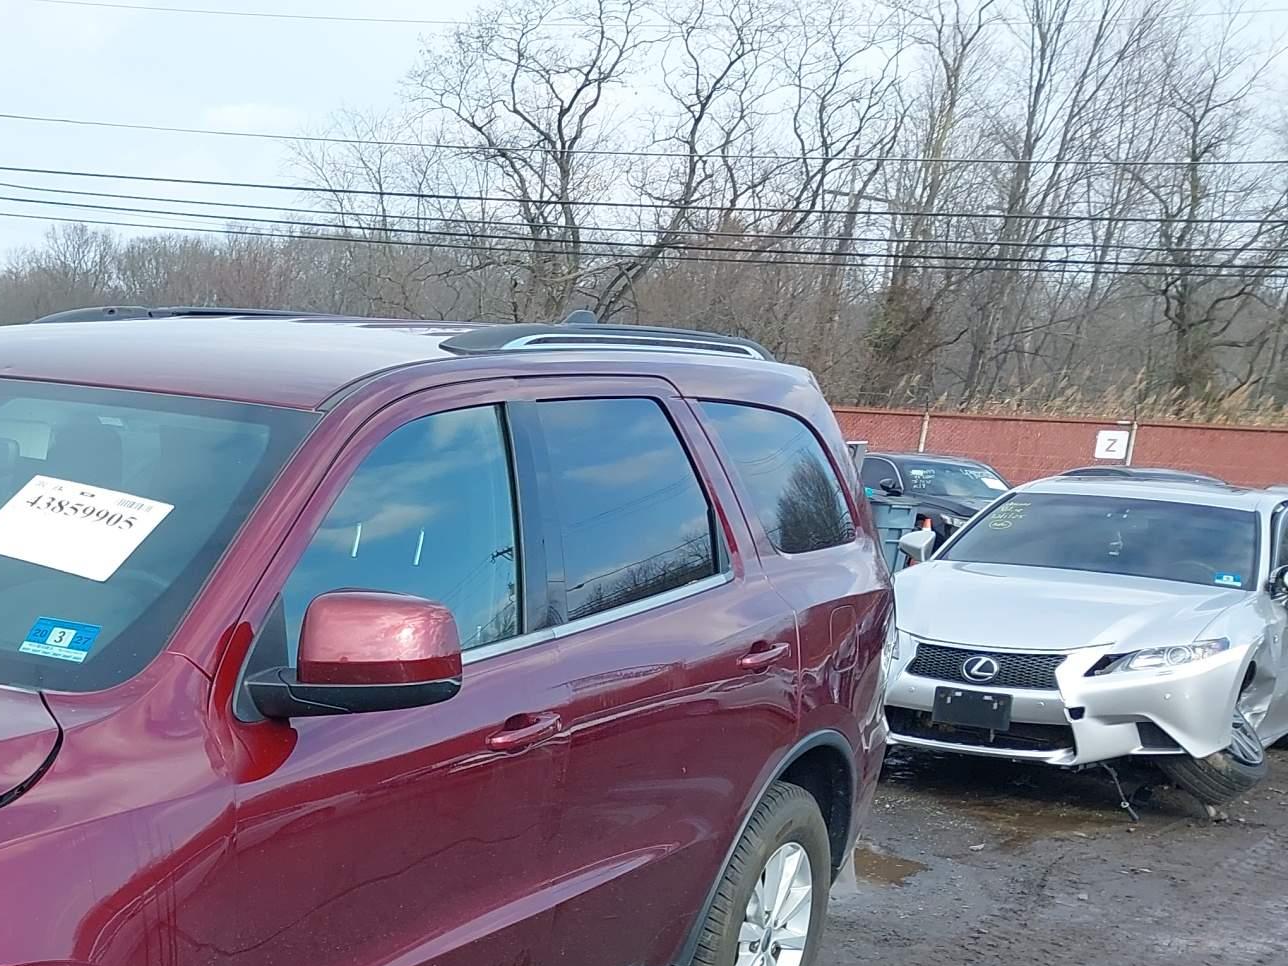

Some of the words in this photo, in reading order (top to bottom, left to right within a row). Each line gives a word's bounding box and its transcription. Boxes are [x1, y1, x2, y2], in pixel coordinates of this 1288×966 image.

[1105, 438, 1119, 453] Z
[26, 494, 138, 530] 43859905
[33, 628, 49, 638] 20
[54, 630, 66, 644] 3
